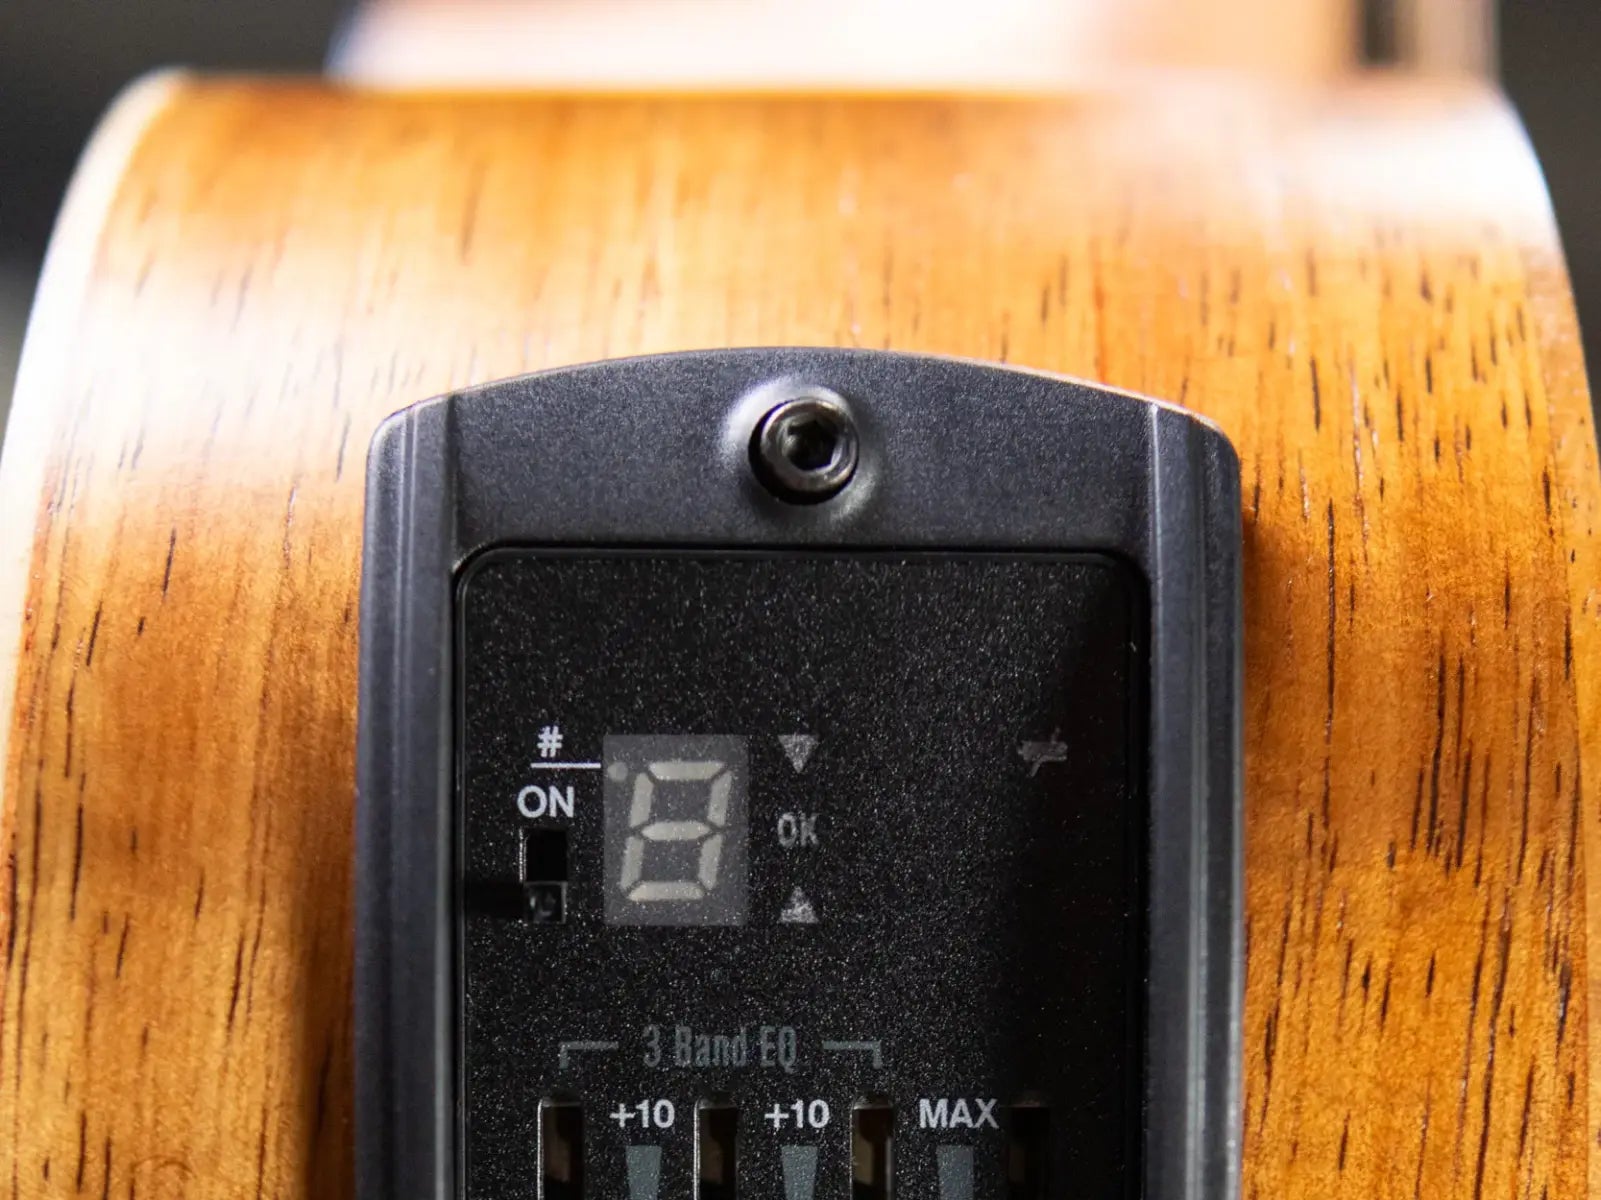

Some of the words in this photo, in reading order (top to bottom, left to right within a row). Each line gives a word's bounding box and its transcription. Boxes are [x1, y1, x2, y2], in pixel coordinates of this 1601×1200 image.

[516, 785, 575, 819] ON
[776, 812, 821, 848] OK
[643, 1027, 661, 1068] 3
[675, 1026, 748, 1068] Band
[761, 1026, 798, 1073] EQ
[609, 1099, 675, 1129] +10
[764, 1099, 831, 1129] +10
[919, 1099, 999, 1128] MAX
